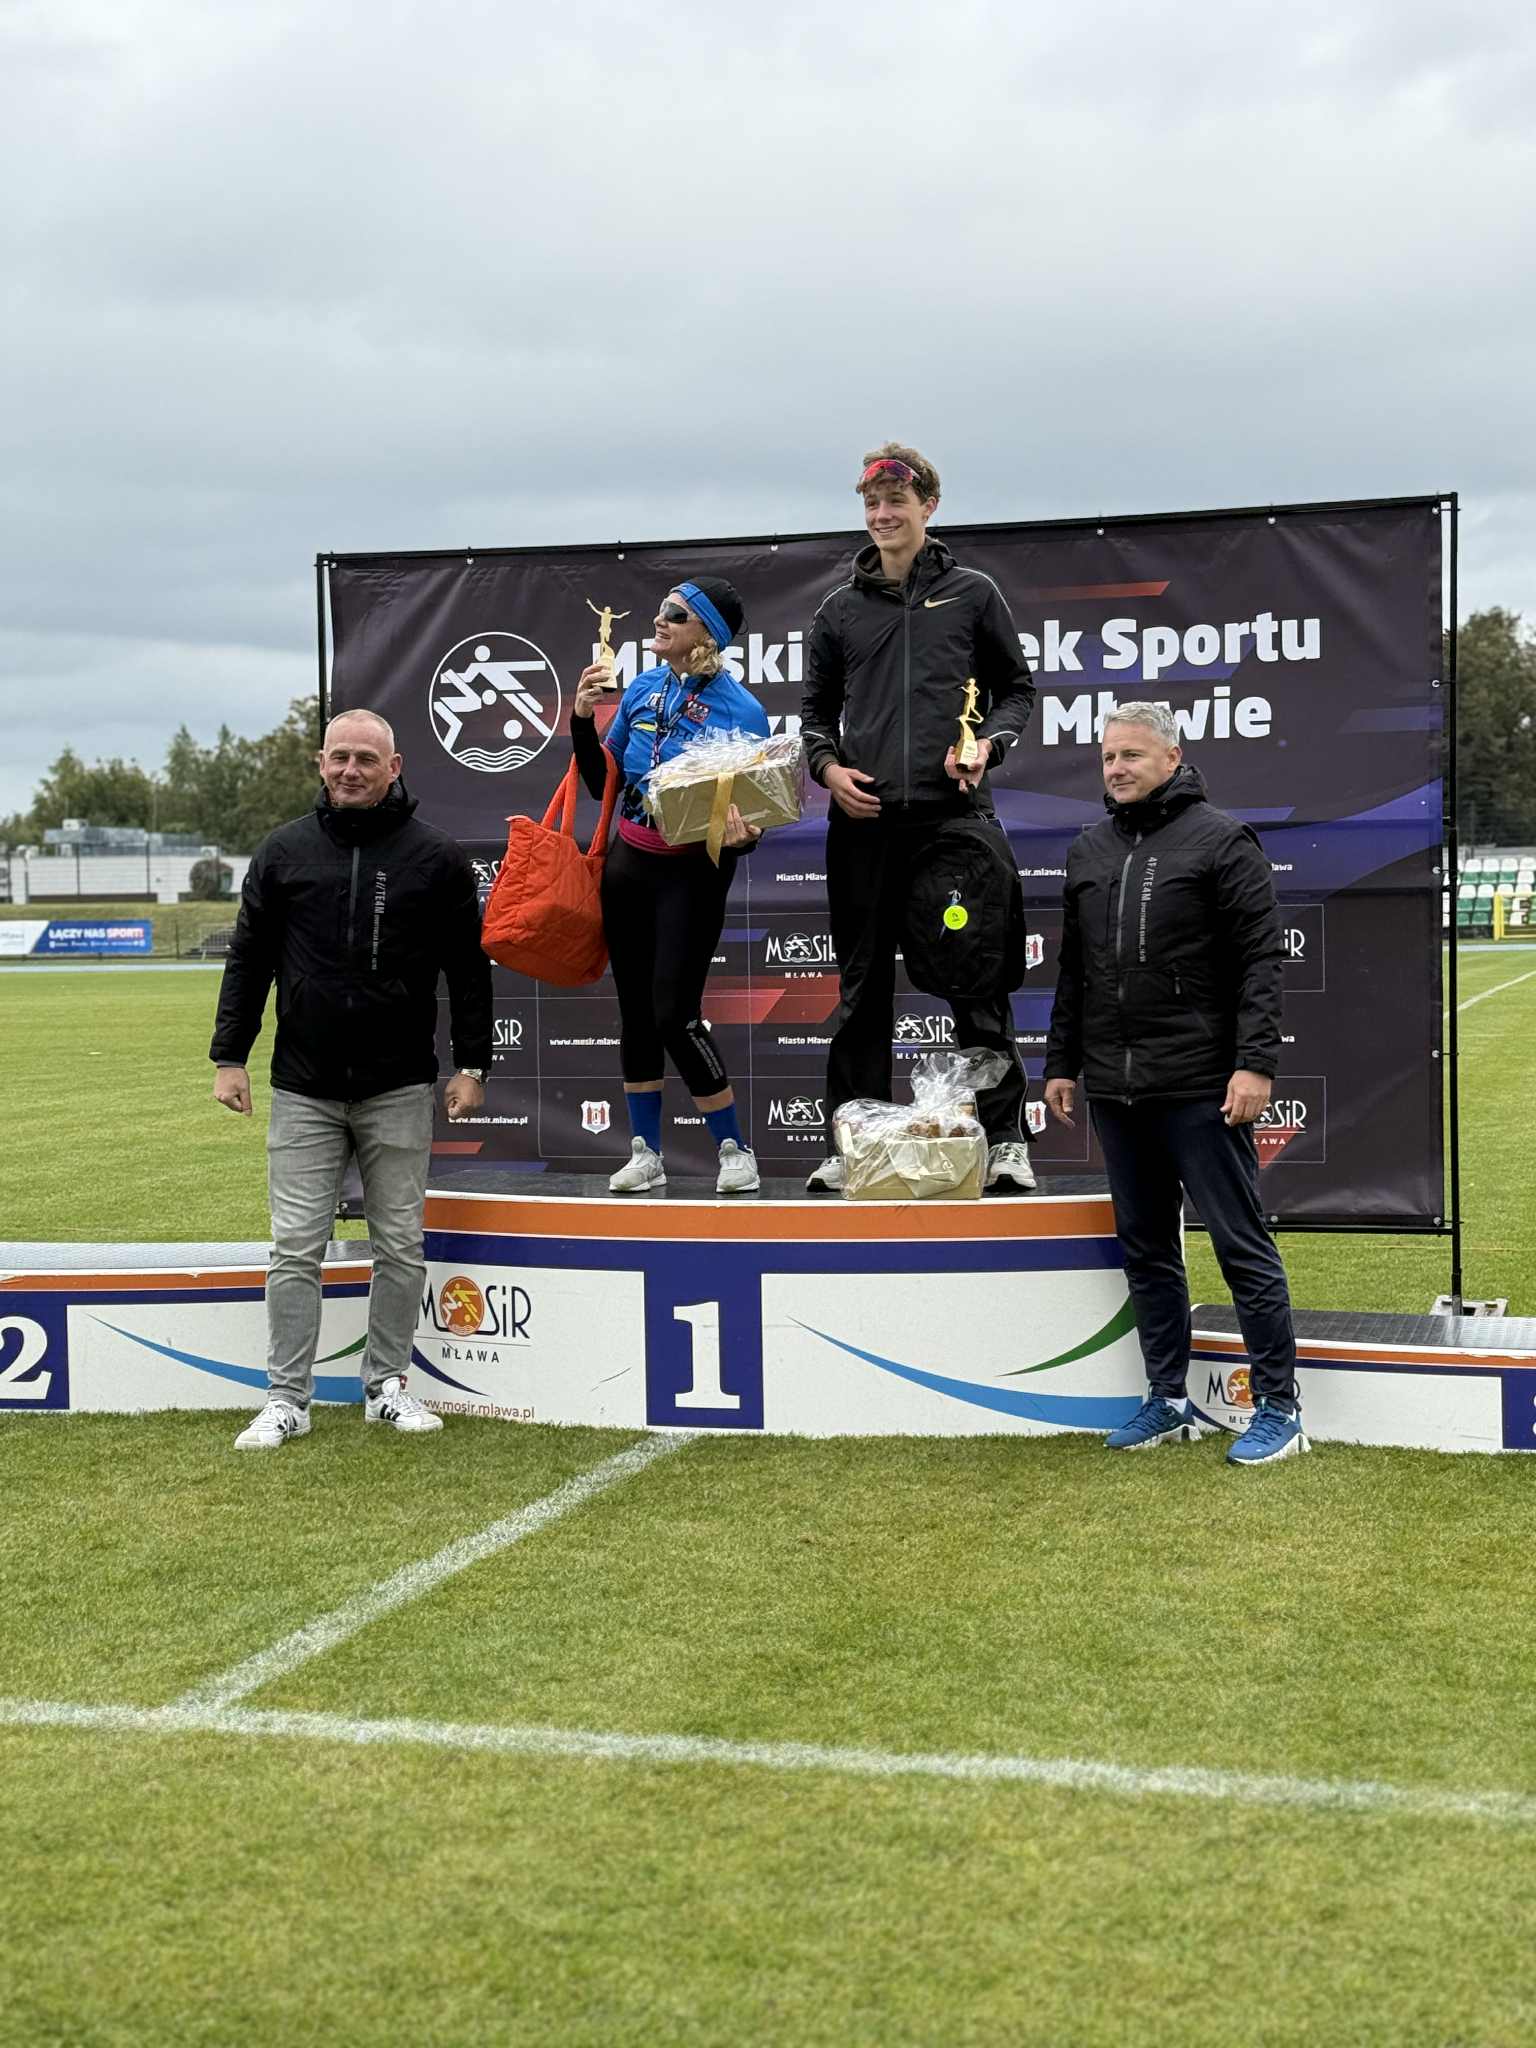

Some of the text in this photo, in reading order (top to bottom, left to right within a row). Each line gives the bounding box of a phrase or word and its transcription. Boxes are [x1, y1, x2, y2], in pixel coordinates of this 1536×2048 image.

[1101, 612, 1321, 680] Sportu
[1042, 686, 1272, 746] Młwie
[84, 928, 105, 938] NAS
[674, 1117, 700, 1125] Miasto
[0, 1316, 52, 1399] 2
[441, 1346, 500, 1363] MŁAWA
[673, 1301, 740, 1409] 1
